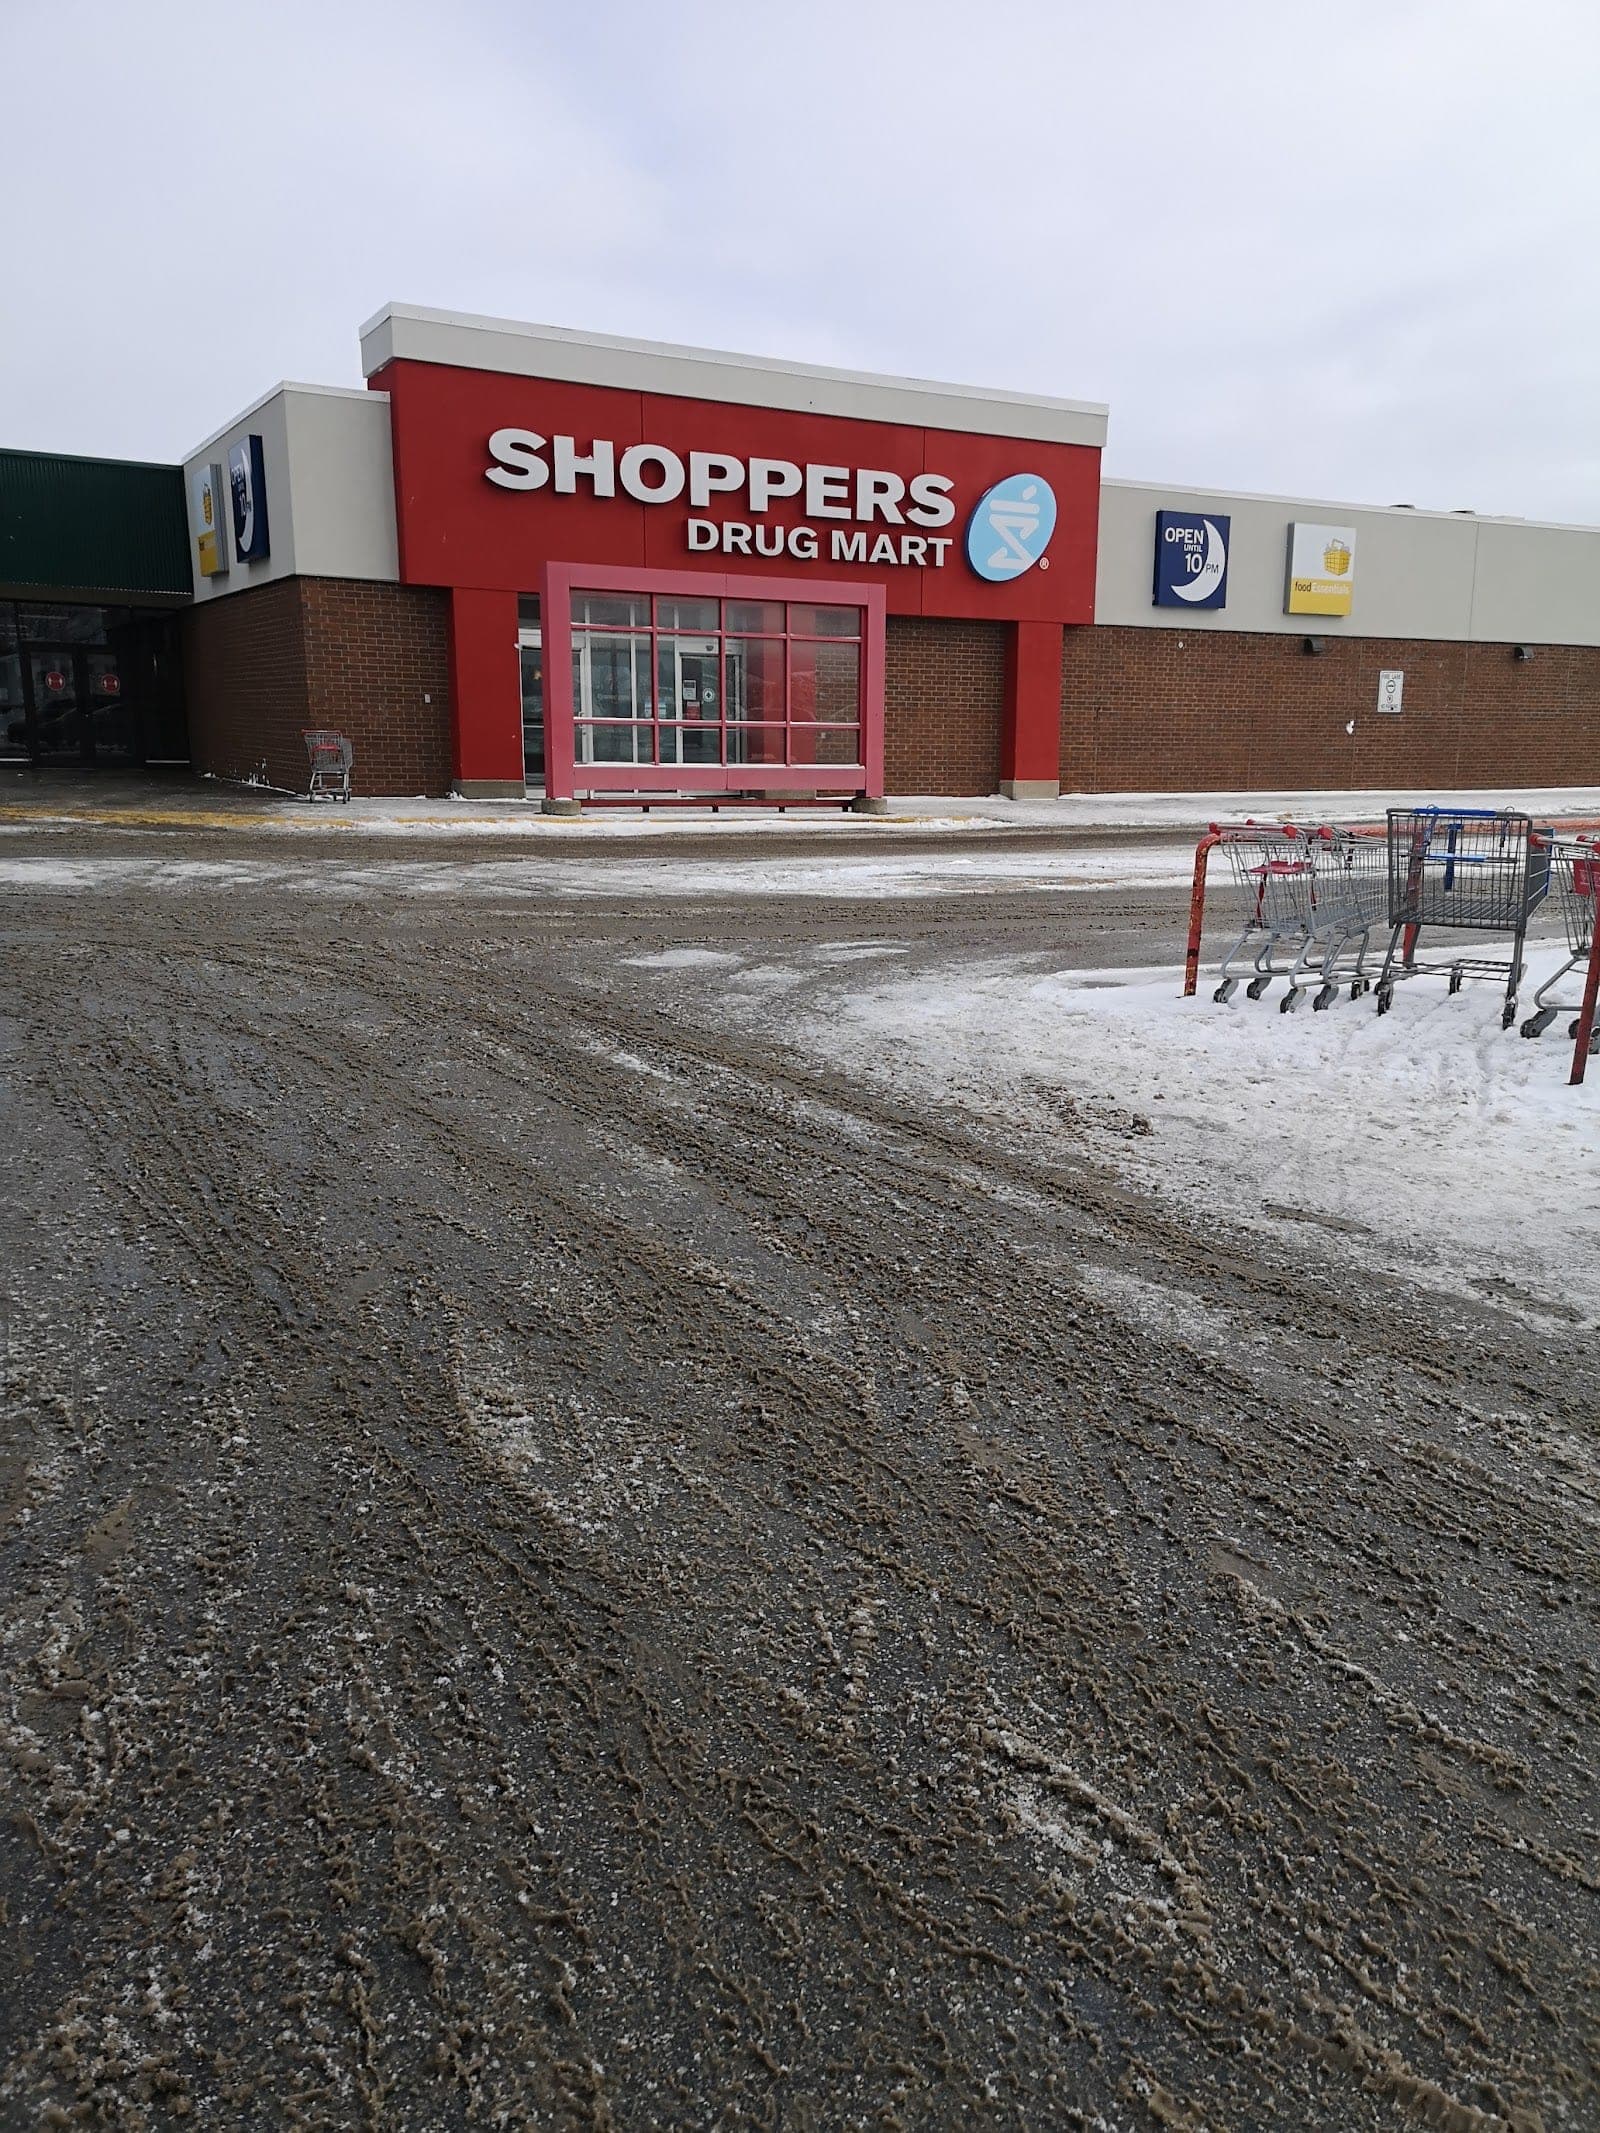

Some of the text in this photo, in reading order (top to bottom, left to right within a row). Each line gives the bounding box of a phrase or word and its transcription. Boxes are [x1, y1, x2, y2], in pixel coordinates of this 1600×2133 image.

[485, 428, 956, 528] SHOPPERS
[687, 518, 953, 567] DRUG MART
[1165, 527, 1204, 545] OPEN
[1184, 544, 1203, 553] UNTIL
[1185, 553, 1220, 575] 10 PM
